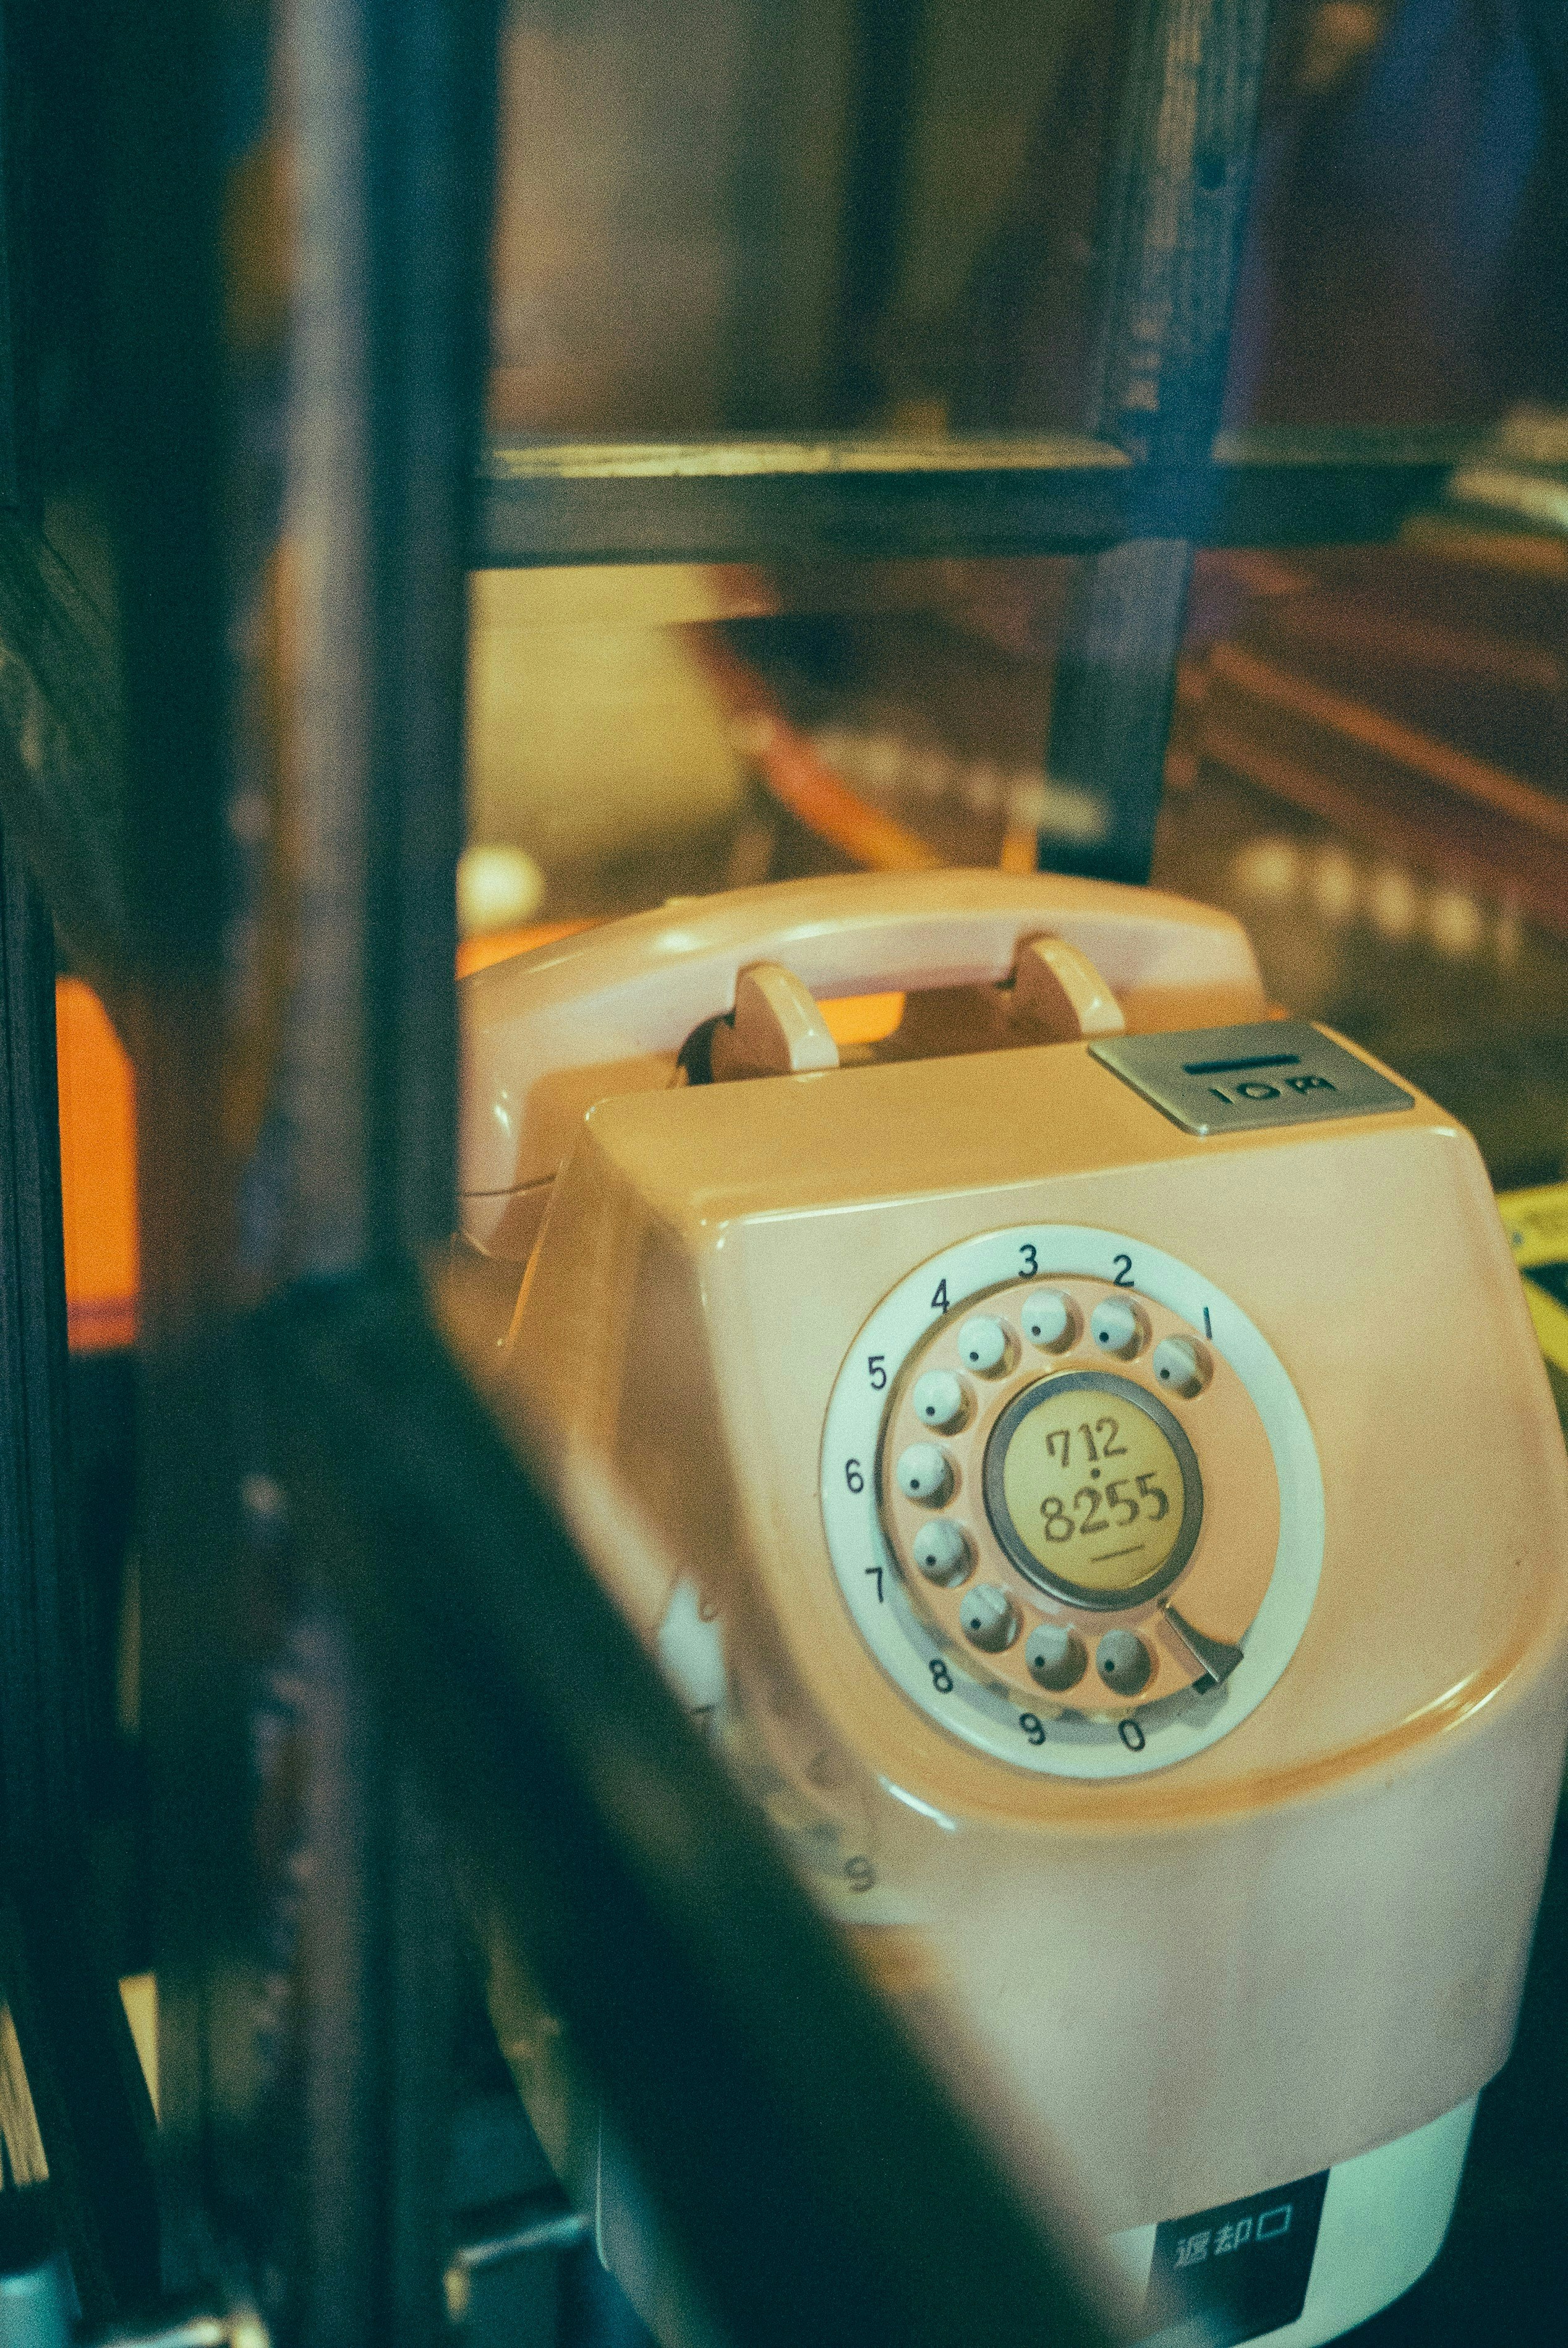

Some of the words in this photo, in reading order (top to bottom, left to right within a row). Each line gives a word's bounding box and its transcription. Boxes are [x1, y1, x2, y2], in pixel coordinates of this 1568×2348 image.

[1018, 1244, 1038, 1278] 3
[1113, 1255, 1134, 1287] 2
[931, 1278, 950, 1315] 4
[1202, 1306, 1212, 1339] 1
[867, 1355, 887, 1390] 5
[1045, 1417, 1128, 1467] 712
[845, 1458, 864, 1493] 6
[1040, 1472, 1170, 1542] 8255
[865, 1567, 884, 1603] 7
[929, 1659, 953, 1694] 8
[1019, 1713, 1047, 1746] 9
[1117, 1718, 1146, 1752] 0
